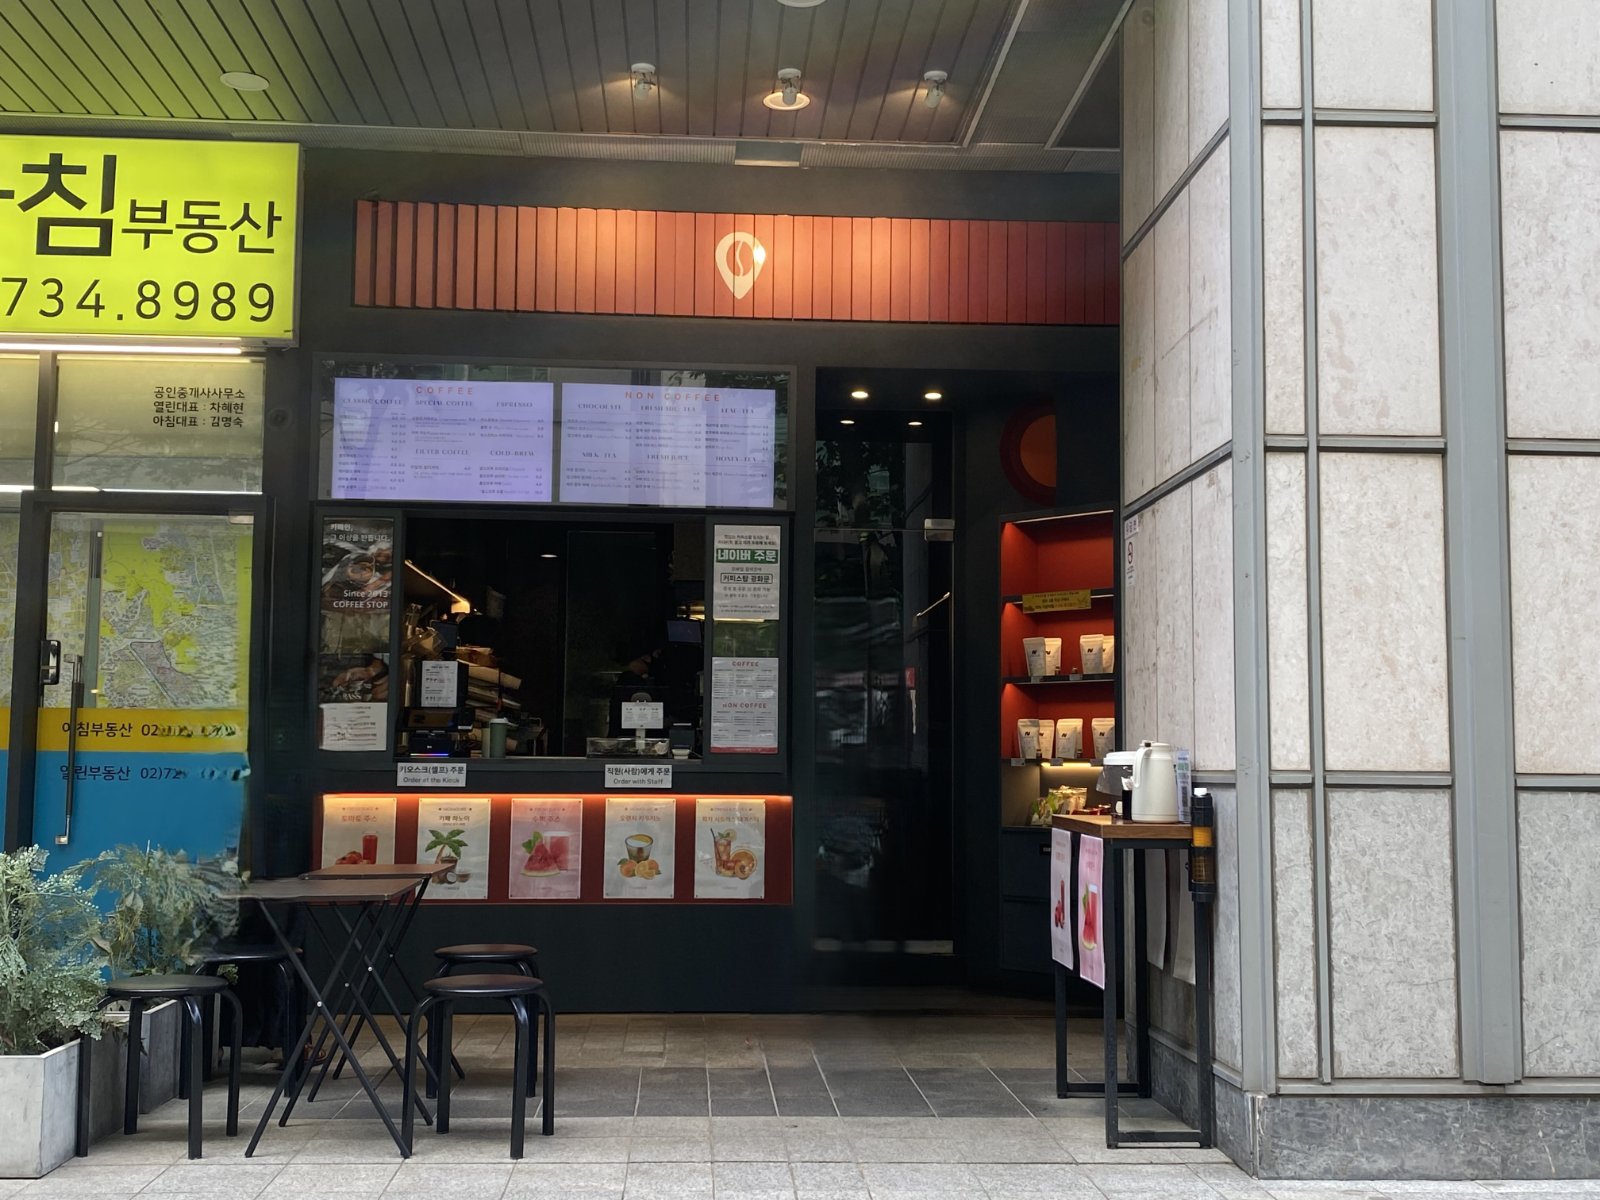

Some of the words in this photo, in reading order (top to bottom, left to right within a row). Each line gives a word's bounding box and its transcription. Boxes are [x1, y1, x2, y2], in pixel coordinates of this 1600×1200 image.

[1, 276, 275, 323] 734.8989
[153, 386, 245, 400] 공인중개사사무소
[415, 385, 474, 396] COFFEE
[625, 391, 655, 400] NON
[664, 393, 721, 402] COFFEE
[153, 400, 199, 414] 열린대표
[209, 402, 244, 416] 차혜현
[152, 415, 199, 429] 아침대표
[210, 416, 244, 429] 김명숙
[717, 548, 751, 561] 네이버
[753, 549, 777, 562] 주문
[722, 574, 748, 582] 커피스탑
[750, 575, 771, 583] 광화문
[343, 589, 365, 598] Since
[332, 600, 365, 609] COFFEE
[366, 600, 389, 609] STOP
[731, 660, 760, 668] COFFEE
[449, 765, 465, 775] 주문
[656, 767, 670, 776] 주문
[402, 776, 421, 784] Order
